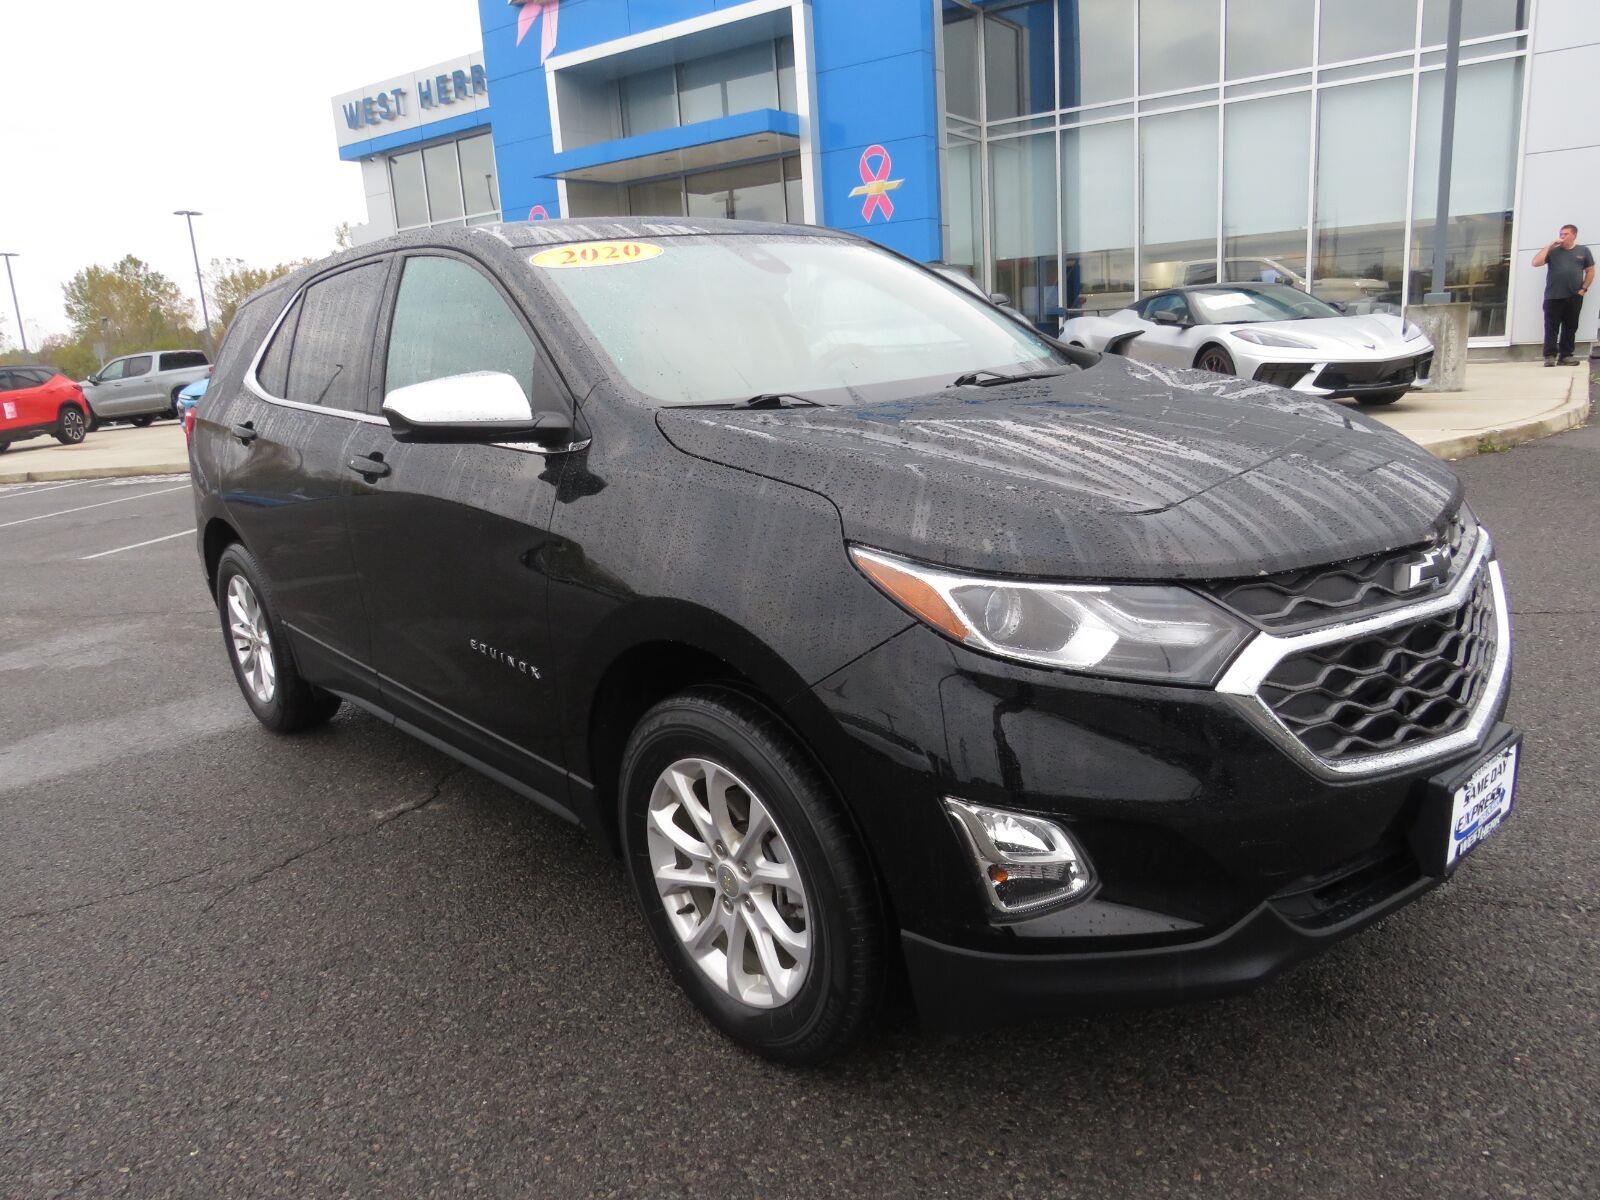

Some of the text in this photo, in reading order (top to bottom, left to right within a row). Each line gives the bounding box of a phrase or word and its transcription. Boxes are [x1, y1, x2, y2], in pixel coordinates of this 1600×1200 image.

[342, 64, 488, 129] WEST HERR
[560, 244, 641, 265] 2020
[470, 638, 541, 680] EQUINOX
[1457, 782, 1503, 830] EXPRESS
[1463, 772, 1490, 807] SAME
[1490, 760, 1508, 783] DAY
